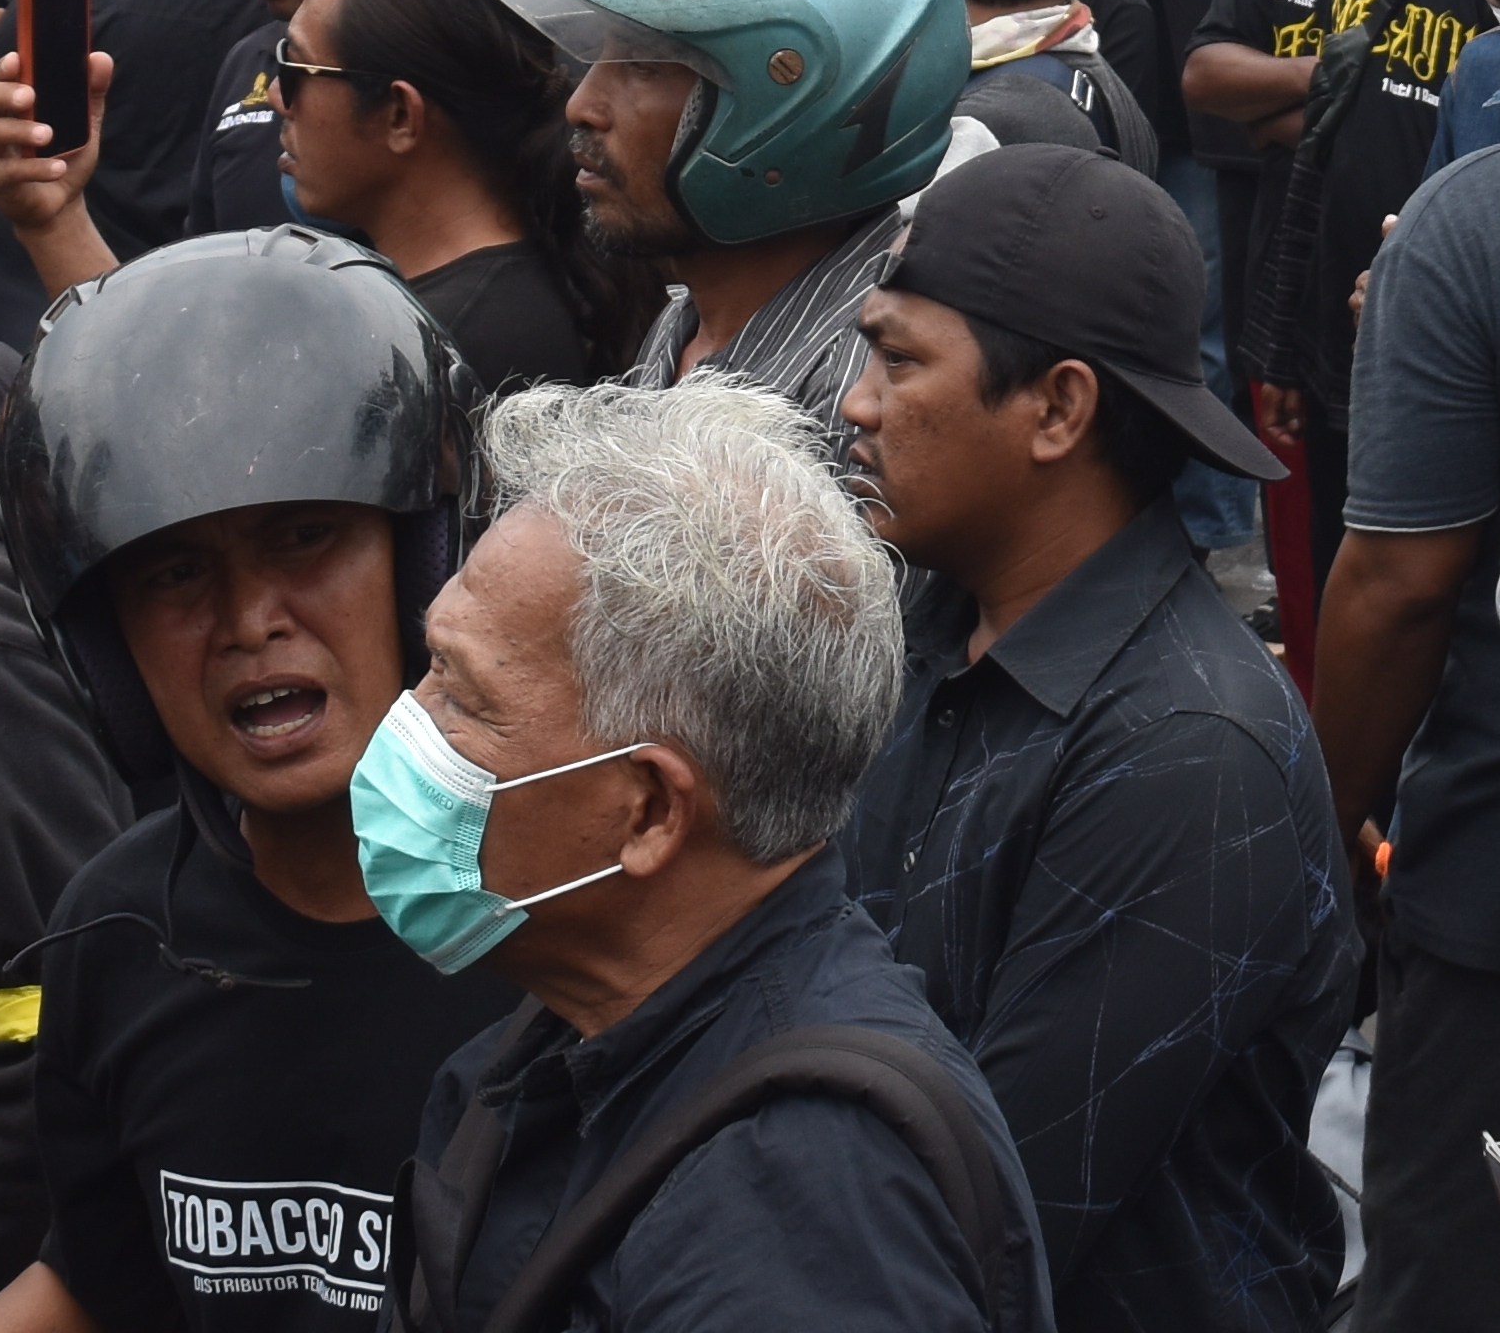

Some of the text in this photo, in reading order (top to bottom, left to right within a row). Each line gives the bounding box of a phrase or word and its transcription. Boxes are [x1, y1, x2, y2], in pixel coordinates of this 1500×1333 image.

[168, 1190, 394, 1274] TOBACCO S
[193, 1274, 299, 1296] DISTRIBUTOR
